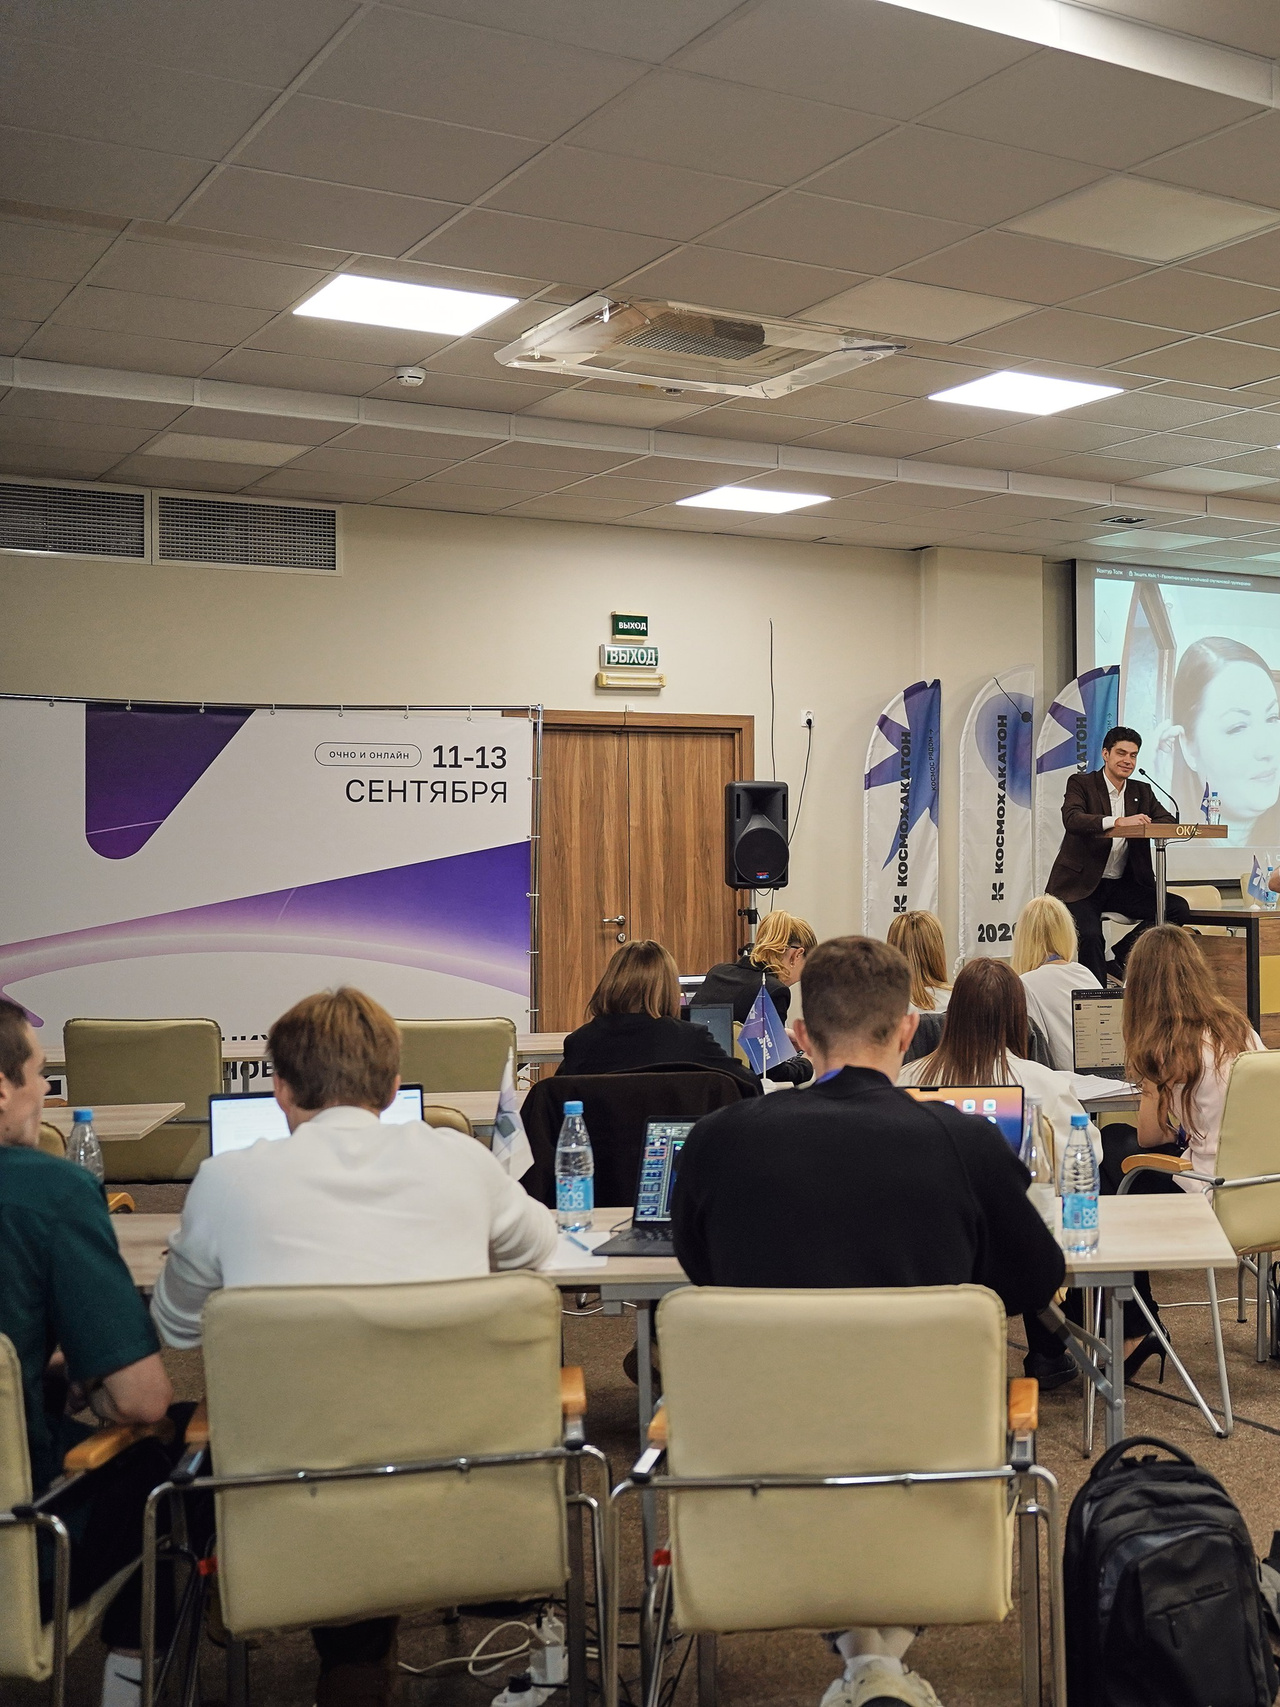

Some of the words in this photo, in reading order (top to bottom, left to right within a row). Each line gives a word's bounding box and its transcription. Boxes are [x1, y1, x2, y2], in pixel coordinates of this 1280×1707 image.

[618, 621, 647, 631] ВЫХОД
[610, 648, 656, 666] ВЫХОД
[329, 751, 357, 759] ОЧНО
[360, 751, 366, 759] И
[369, 751, 410, 760] ОНЛАЙН
[433, 745, 507, 769] 11-13
[929, 761, 937, 791] КОСМОС
[345, 779, 507, 804] СЕНТЯБРЯ
[995, 714, 1008, 874] КОСМОХАКАТОН
[897, 731, 911, 887] КОСМОХАКАТОН
[977, 922, 1017, 943] 202
